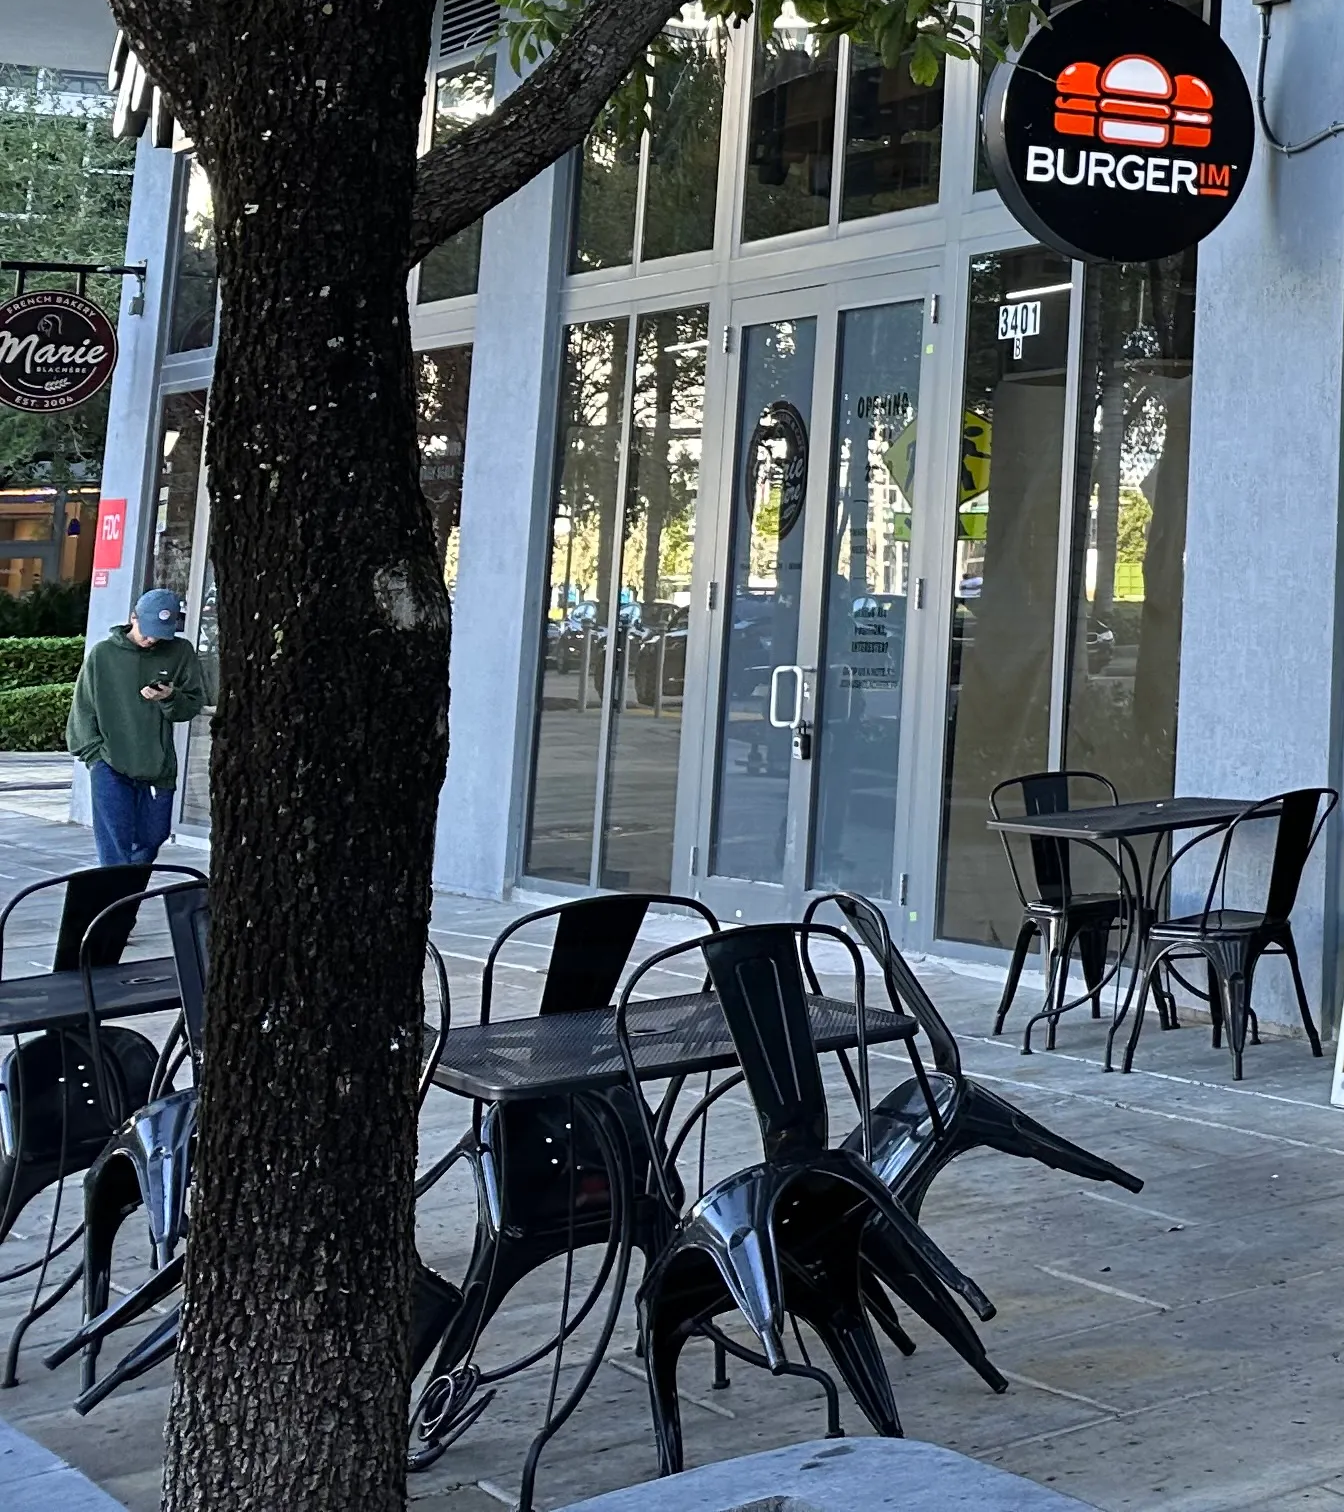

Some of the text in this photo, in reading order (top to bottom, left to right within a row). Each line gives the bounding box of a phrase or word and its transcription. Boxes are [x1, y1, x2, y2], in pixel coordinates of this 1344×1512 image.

[1026, 145, 1230, 196] BURGERIM
[7, 296, 97, 318] FRENCH BAKERY
[1001, 304, 1038, 337] 3401
[0, 330, 108, 374] Marie
[1015, 338, 1021, 357] B
